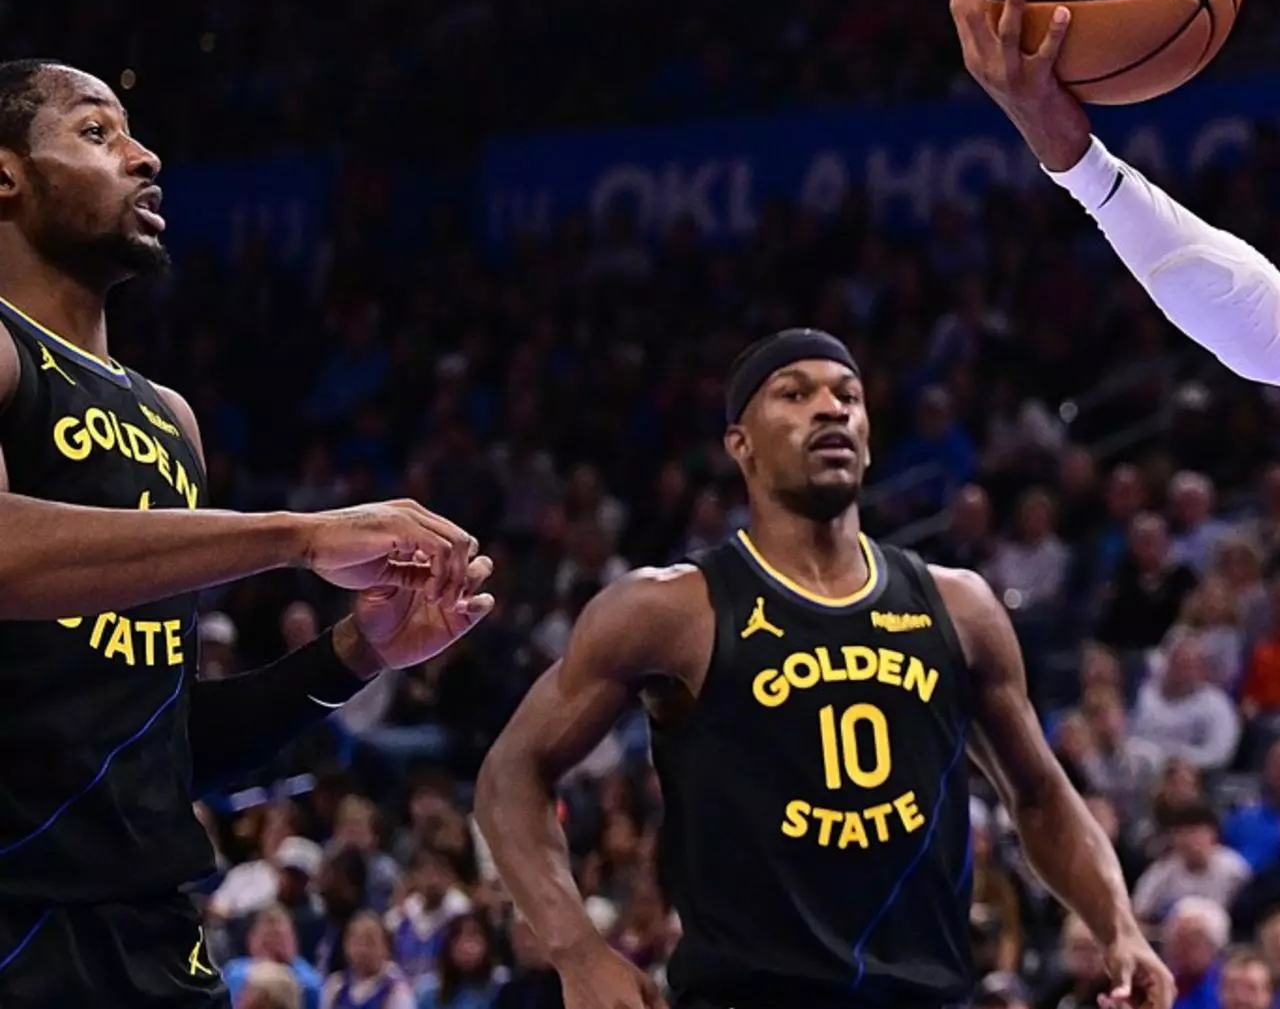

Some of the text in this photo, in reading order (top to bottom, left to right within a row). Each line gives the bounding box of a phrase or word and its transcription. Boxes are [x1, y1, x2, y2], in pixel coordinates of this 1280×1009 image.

[54, 407, 198, 510] GOLDEN
[57, 611, 184, 666] TATE
[752, 645, 939, 707] GOLDEN
[819, 703, 891, 790] 10
[781, 790, 925, 849] STATE
